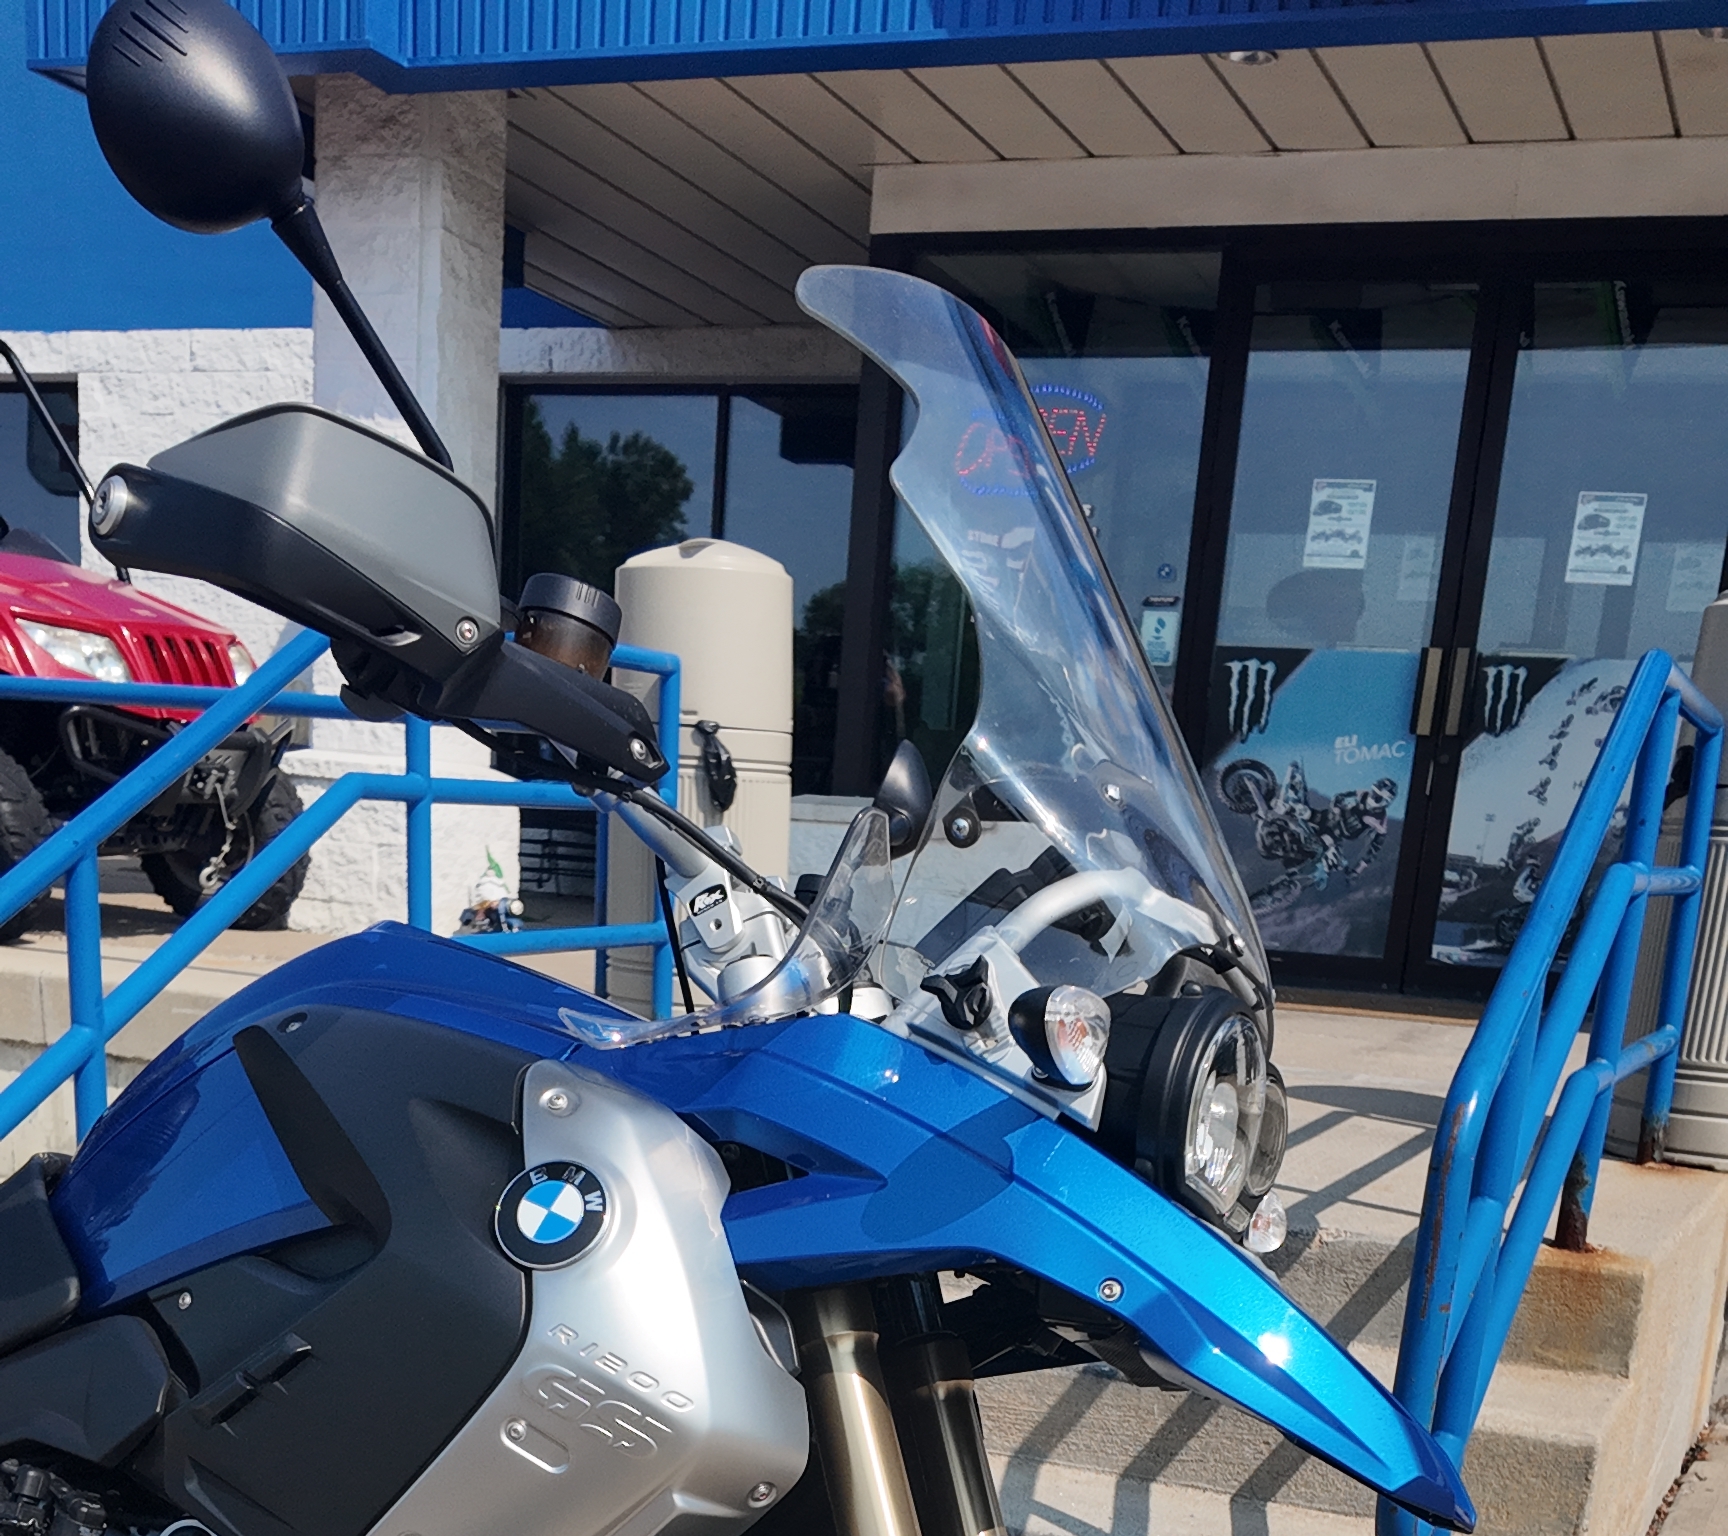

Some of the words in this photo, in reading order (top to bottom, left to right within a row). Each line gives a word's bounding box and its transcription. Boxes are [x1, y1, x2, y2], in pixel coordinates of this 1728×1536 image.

[1334, 733, 1359, 749] ELI
[1334, 740, 1407, 765] TOMAC
[529, 1165, 604, 1212] BMW
[522, 1363, 674, 1460] GS
